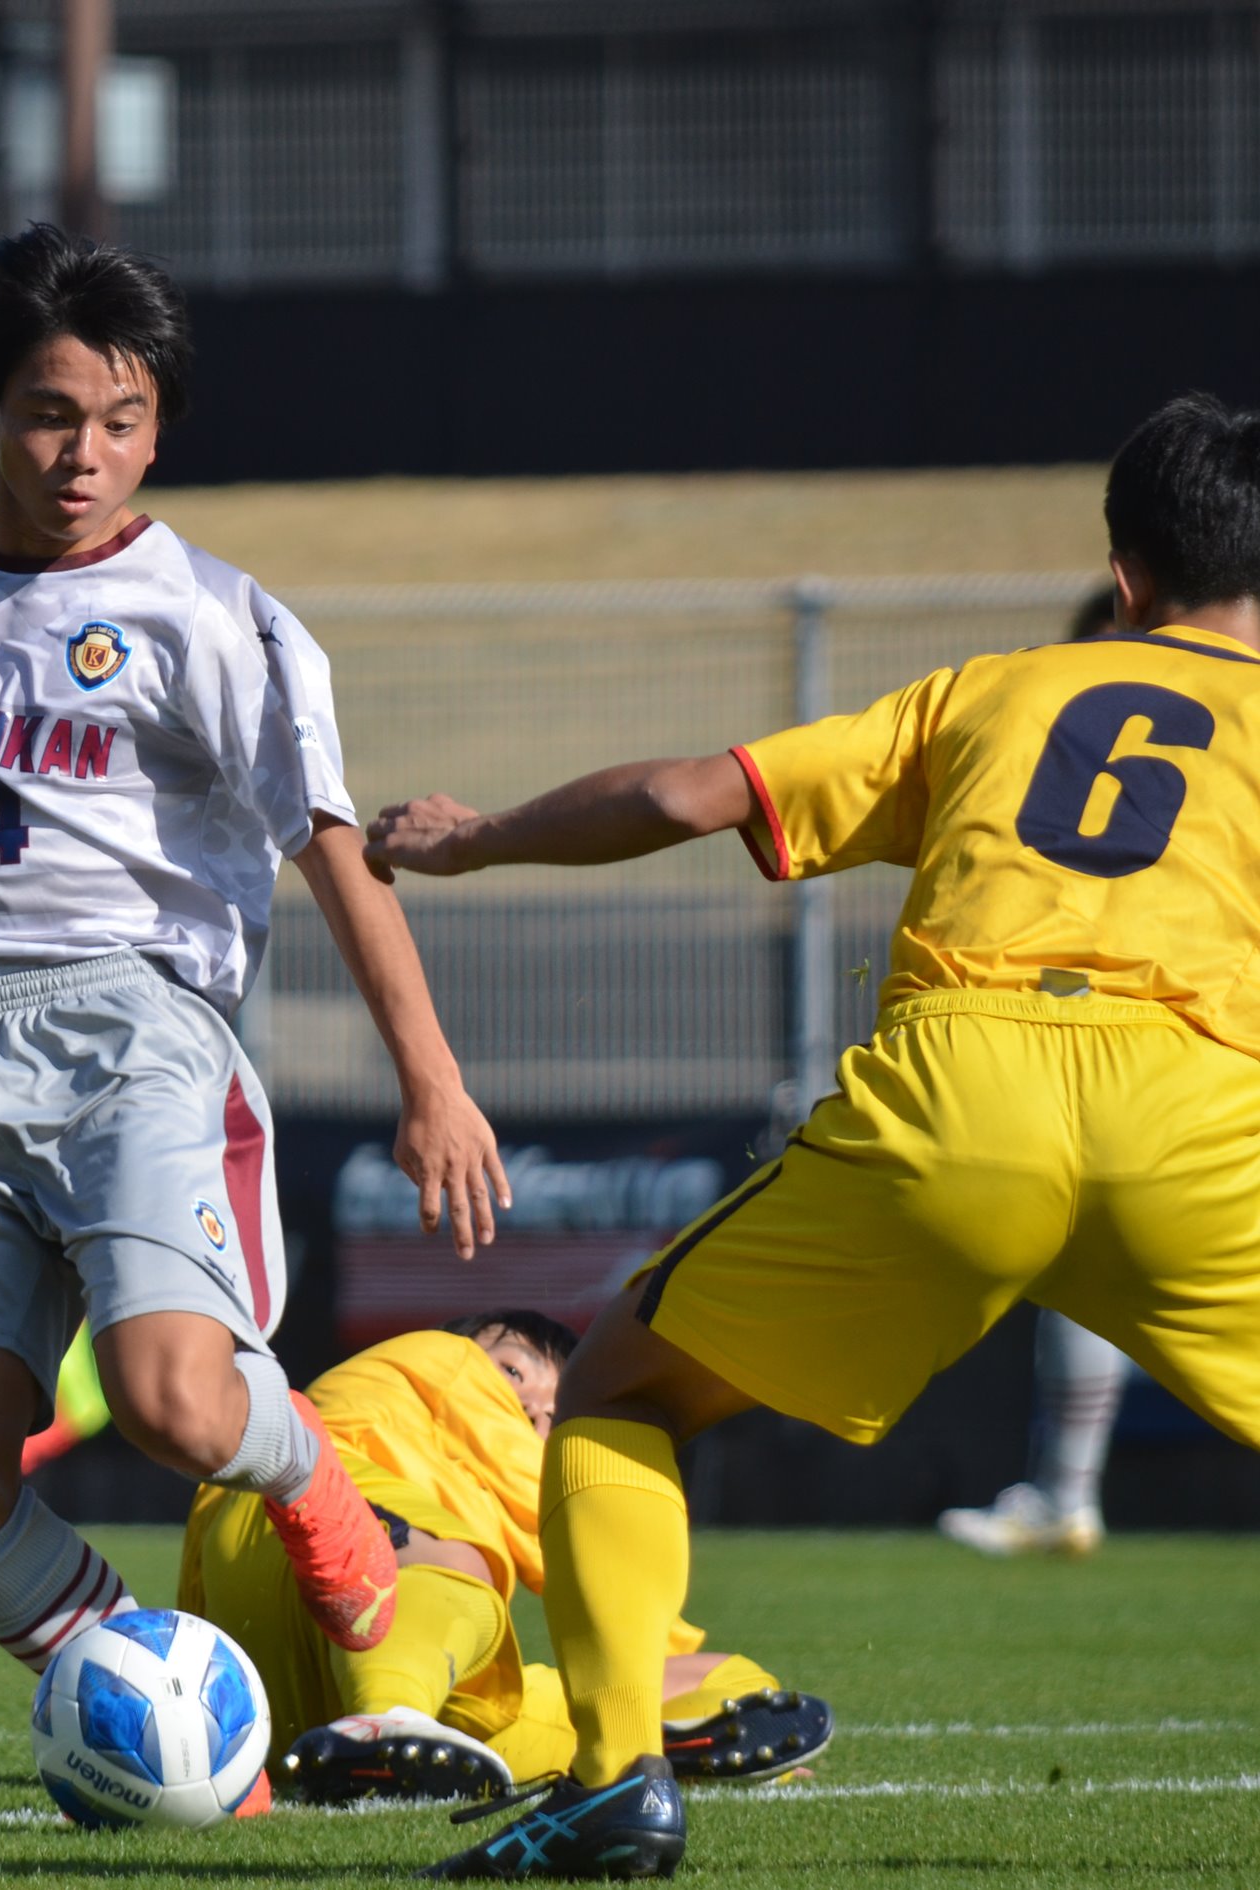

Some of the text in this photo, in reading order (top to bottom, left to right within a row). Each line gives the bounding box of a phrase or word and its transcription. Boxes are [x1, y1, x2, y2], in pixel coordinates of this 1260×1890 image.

[87, 648, 103, 666] K
[1015, 681, 1215, 879] 6
[65, 1750, 151, 1808] molten
